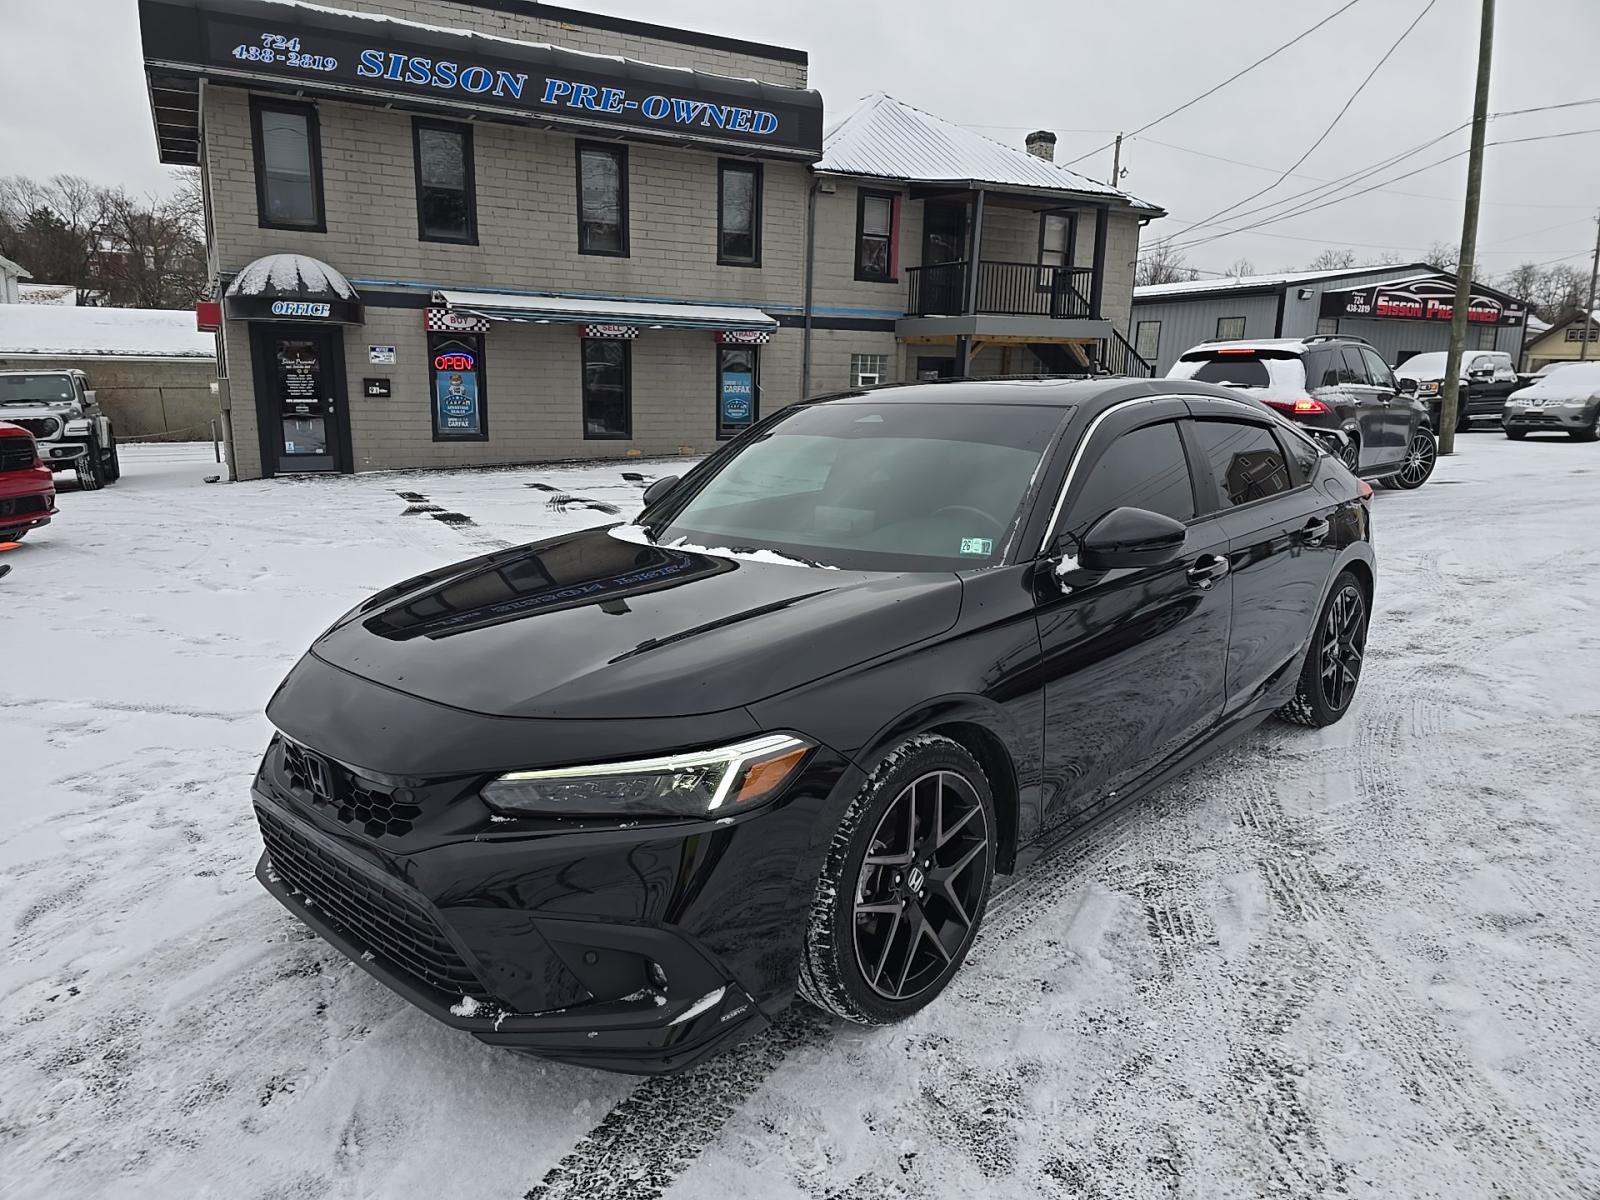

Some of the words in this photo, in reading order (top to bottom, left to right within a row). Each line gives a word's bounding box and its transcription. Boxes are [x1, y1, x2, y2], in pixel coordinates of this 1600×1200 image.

[261, 33, 300, 52] 724
[232, 45, 338, 71] 438-2819
[357, 49, 528, 99] SISSON
[541, 78, 778, 134] PRE-OWNED
[271, 300, 331, 317] OFFICE
[449, 315, 468, 325] BUY
[434, 356, 472, 370] OPEN
[722, 385, 751, 393] CARFAX
